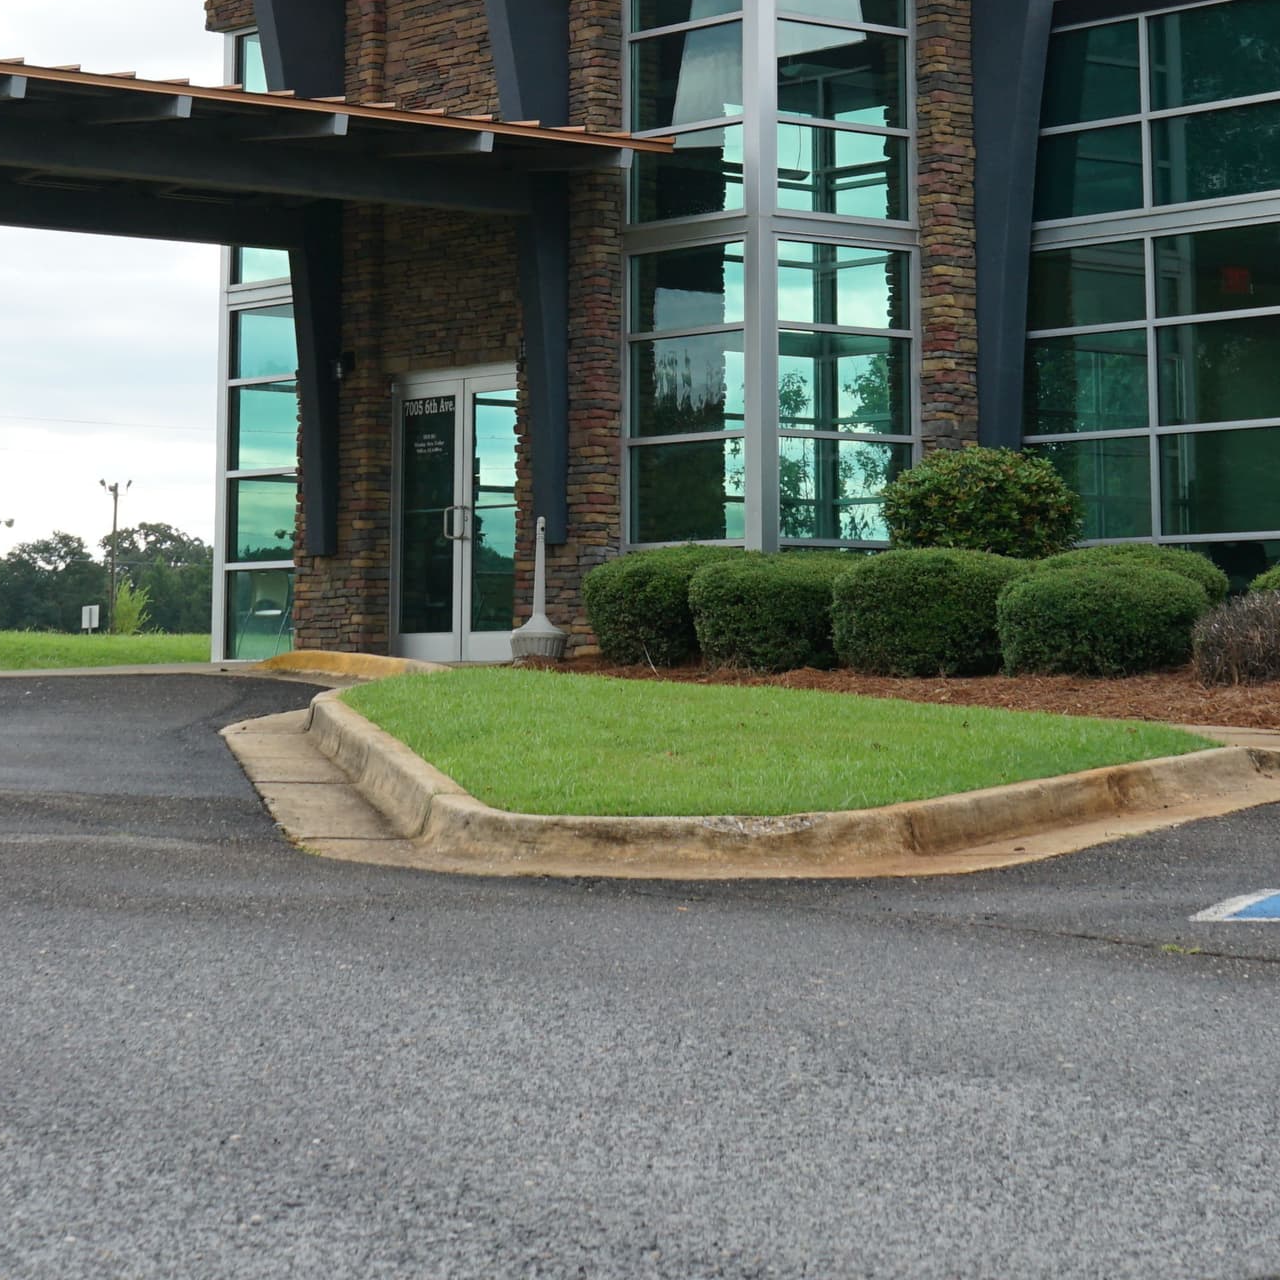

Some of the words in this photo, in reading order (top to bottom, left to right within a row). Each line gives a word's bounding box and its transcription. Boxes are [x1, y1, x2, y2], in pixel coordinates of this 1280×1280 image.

[405, 400, 423, 416] 7005
[425, 399, 438, 414] 6th
[440, 397, 456, 412] Ave.
